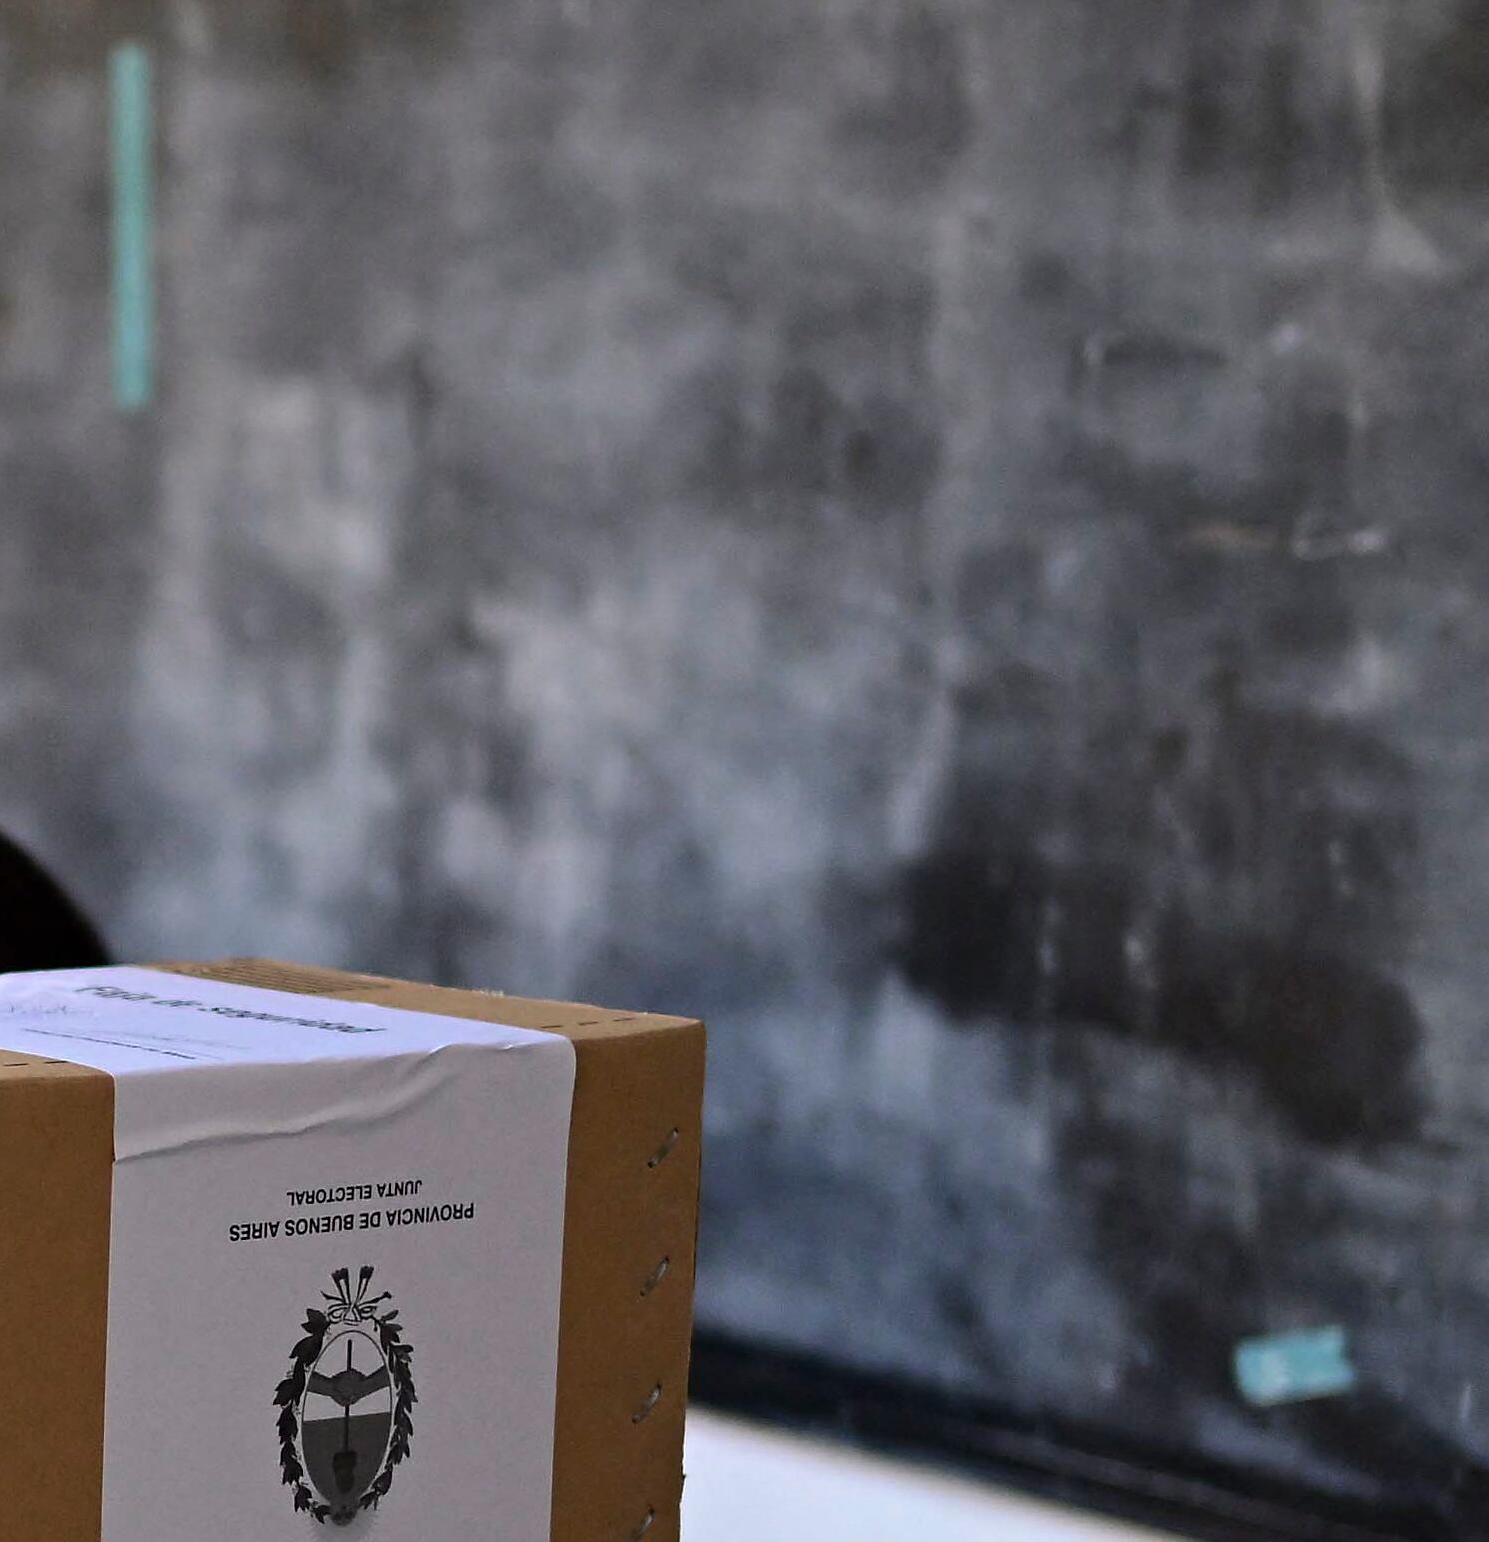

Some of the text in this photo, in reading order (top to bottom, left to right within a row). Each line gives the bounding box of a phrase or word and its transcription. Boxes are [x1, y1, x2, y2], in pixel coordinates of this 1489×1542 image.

[287, 1180, 422, 1206] JUNTA ELECTORAL
[229, 1203, 474, 1241] PROVINCIA DE BUENOS AIRES
